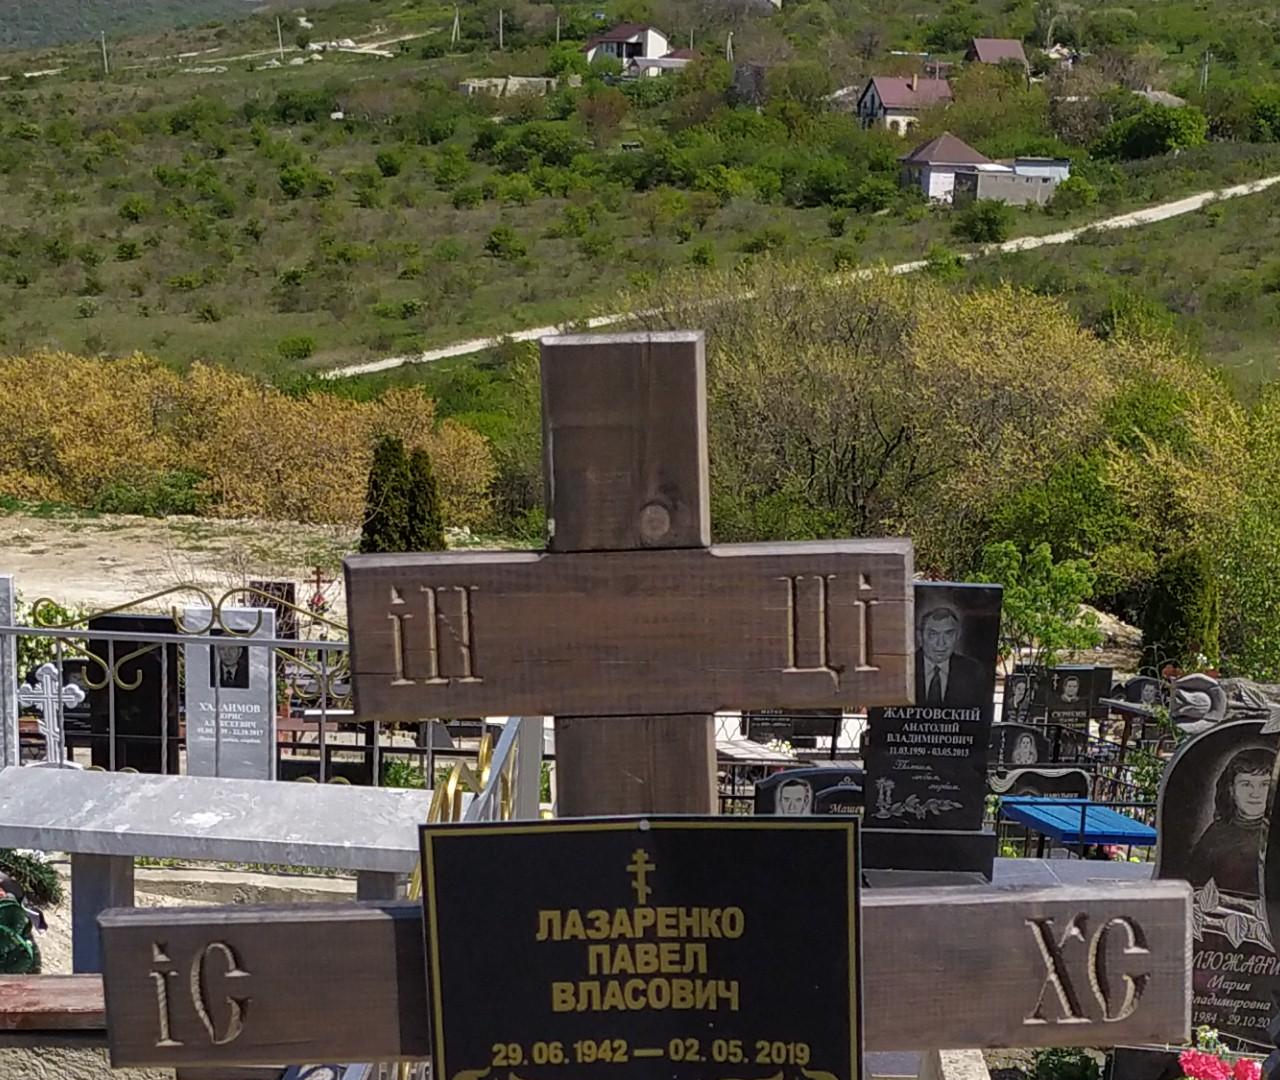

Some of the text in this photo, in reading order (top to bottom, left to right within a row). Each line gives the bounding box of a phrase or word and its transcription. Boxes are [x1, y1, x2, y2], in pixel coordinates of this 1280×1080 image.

[883, 707, 981, 721] ЖАРТОВСКИЙ
[902, 722, 960, 733] АНАТОЛИЙ
[887, 733, 974, 745] ВЛАДИМИРОВИЧ
[535, 907, 745, 941] ЛАЗАРЕНКО
[588, 943, 707, 975] ПАВЕЛ
[1207, 975, 1251, 994] Мария
[552, 978, 739, 1012] ВЛАСОВИЧ
[1190, 992, 1271, 1012] ладимировна
